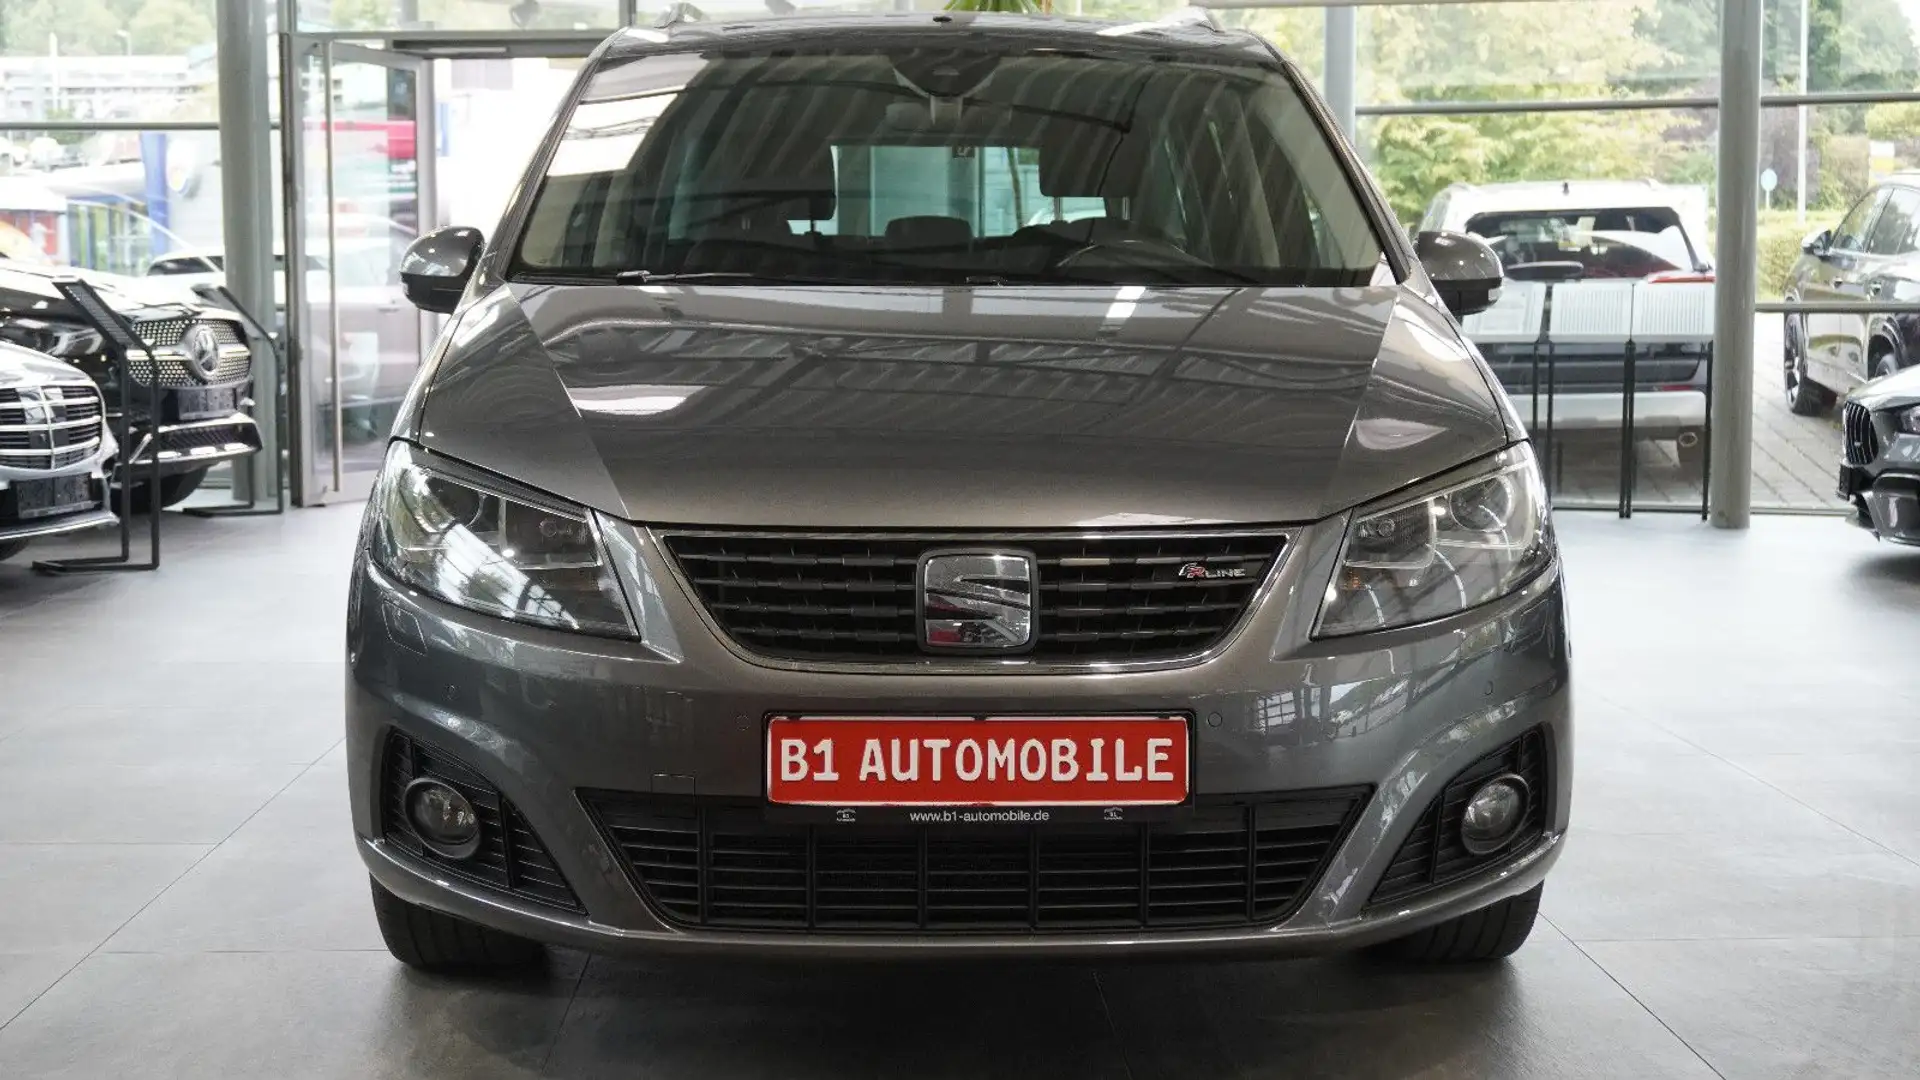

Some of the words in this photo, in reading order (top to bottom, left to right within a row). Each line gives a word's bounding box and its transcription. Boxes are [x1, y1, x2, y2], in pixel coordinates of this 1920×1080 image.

[781, 738, 839, 781] B1
[859, 738, 1173, 781] AUTOMOBILE
[910, 810, 1049, 822] www.b1-automobile.de
